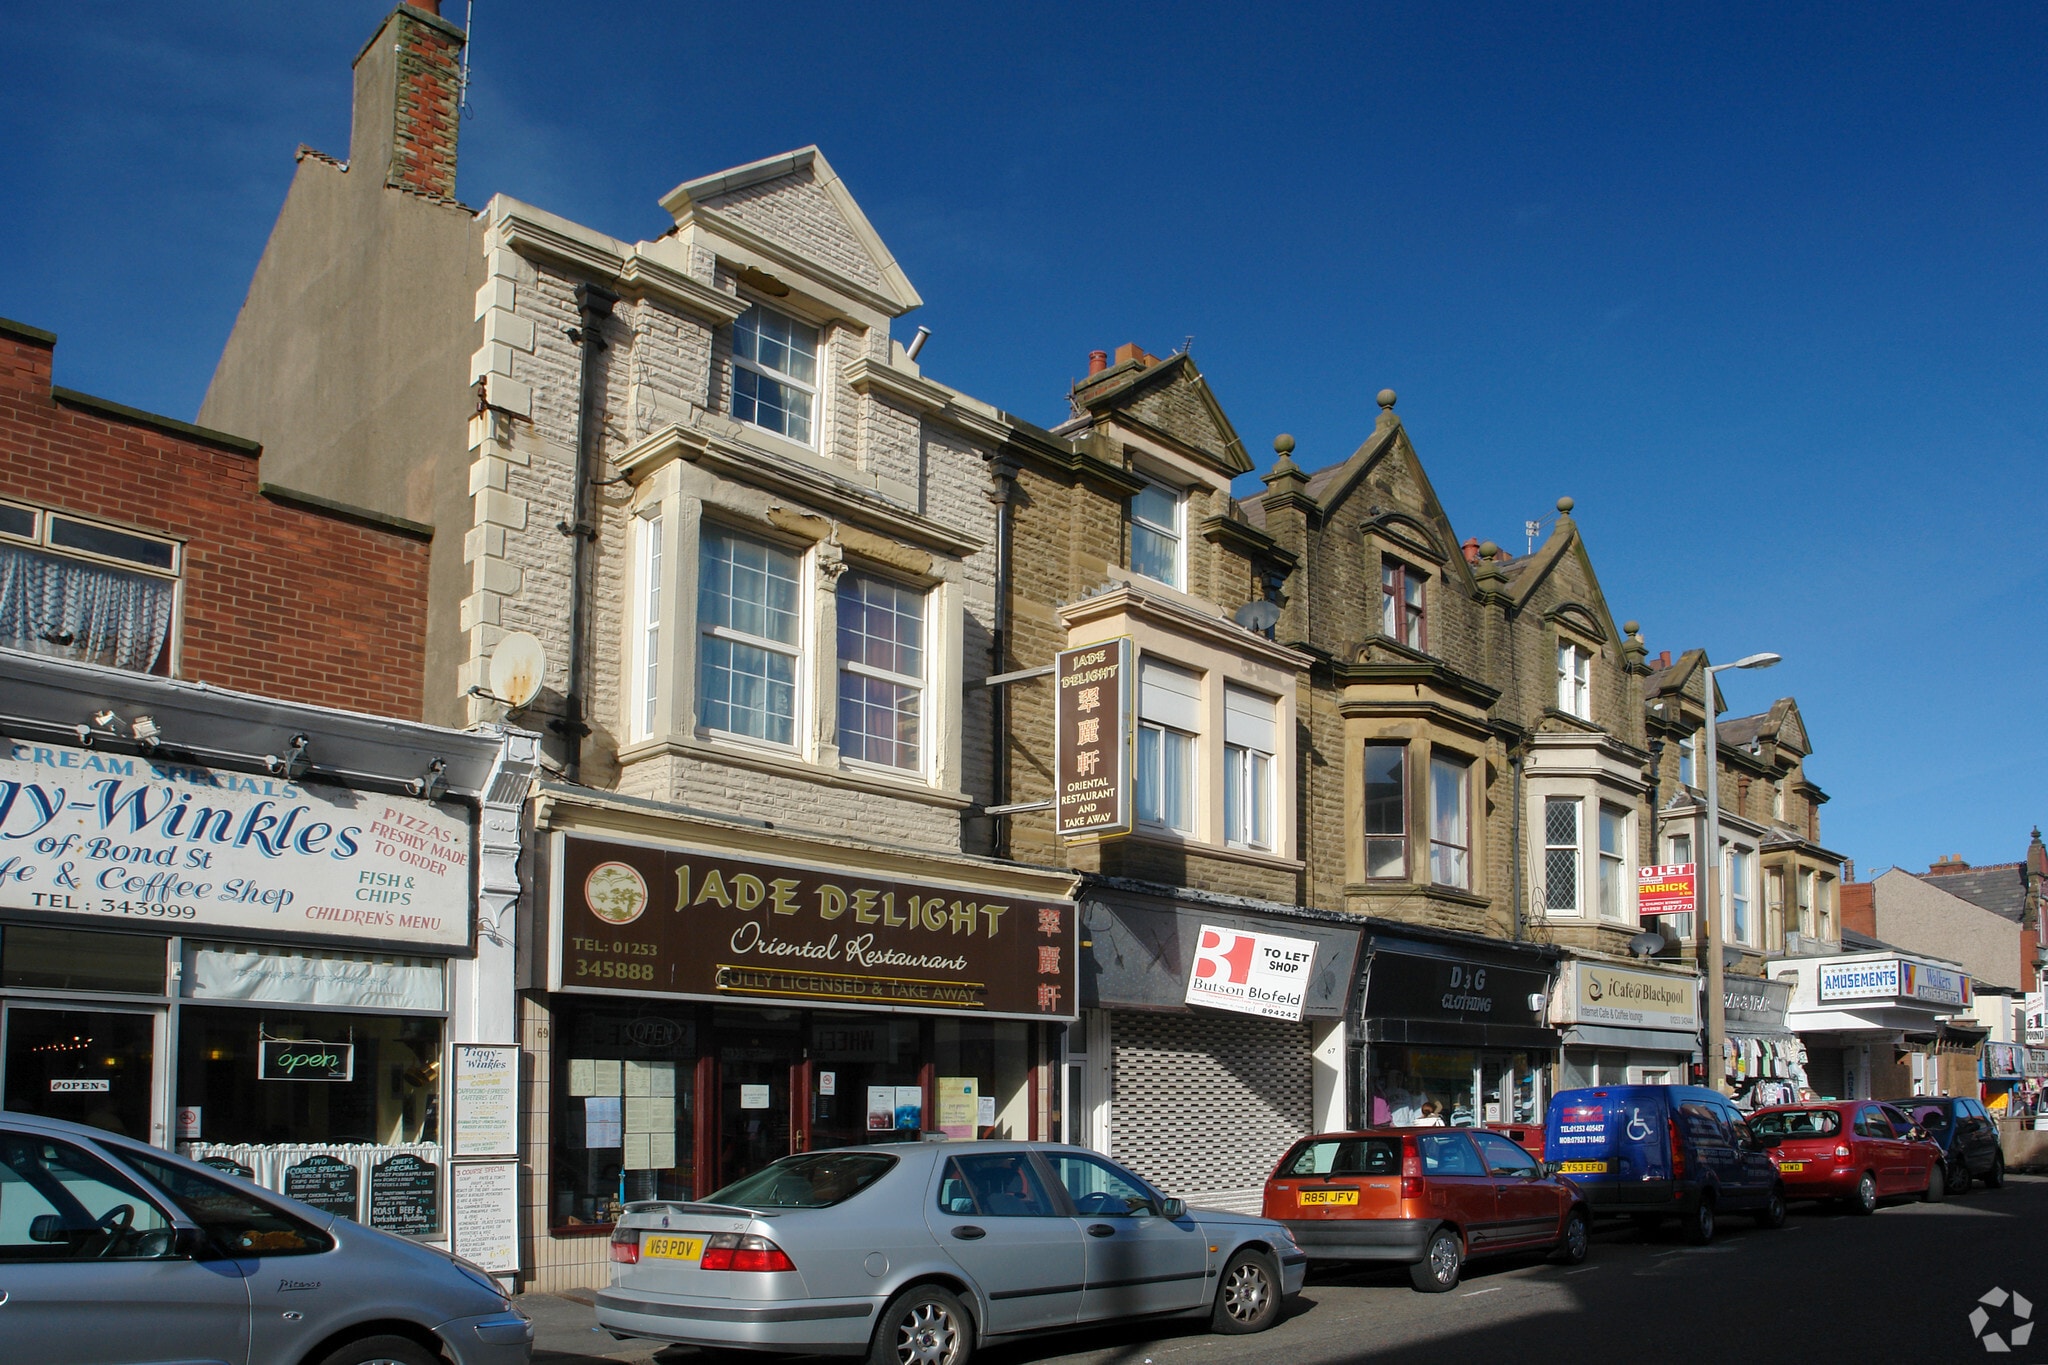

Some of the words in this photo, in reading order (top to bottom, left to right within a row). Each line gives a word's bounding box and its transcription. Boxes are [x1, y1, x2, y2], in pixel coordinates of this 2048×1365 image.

[1073, 650, 1106, 671] JADE
[1061, 664, 1119, 688] DELIGHT
[11, 744, 134, 776] CREAM
[150, 765, 299, 800] SPECIALS
[1067, 777, 1109, 792] ORIENTAL
[1061, 788, 1115, 805] RESTAURANT
[1078, 803, 1097, 814] AND
[384, 807, 452, 843] PIZZAS
[1064, 818, 1085, 828] TAKE
[1086, 812, 1111, 824] AWAY
[34, 833, 81, 860] of
[86, 836, 177, 867] Bond
[185, 848, 212, 871] St
[369, 820, 427, 852] FRESHLY
[429, 839, 468, 867] MADE
[375, 839, 396, 859] TO
[398, 847, 447, 877] ORDER
[1639, 867, 1653, 876] O
[1657, 865, 1686, 875] LET
[54, 861, 80, 891] &
[96, 866, 212, 903] Coffee
[220, 877, 295, 912] Shop
[358, 871, 400, 889] FISH
[403, 876, 416, 889] &
[1639, 882, 1689, 894] ENRICK
[355, 888, 412, 906] CHIPS
[674, 864, 801, 915] JADE
[814, 883, 1010, 938] DELIGHT
[100, 899, 197, 920] 343999
[305, 905, 393, 927] CHILDREN'S
[399, 915, 441, 931] MENU
[573, 938, 609, 953] TEL:
[612, 941, 658, 956] 01253
[730, 921, 840, 962] Oriental
[845, 934, 968, 971] Restaurant
[1264, 947, 1281, 958] TO
[1285, 951, 1309, 963] LET
[575, 958, 654, 982] 345888
[1269, 961, 1298, 973] SHOP
[717, 967, 773, 990] FULLY
[780, 974, 867, 995] LICENSED
[872, 980, 883, 995] &
[887, 981, 928, 998] TAKE
[932, 984, 977, 1002] AWAY
[1824, 970, 1896, 990] AMUSEMENTS
[1926, 968, 1951, 989] Walkers
[1193, 977, 1244, 996] Butson
[1248, 987, 1301, 1005] Blofeld
[1441, 993, 1492, 1012] CLOTHING
[1261, 1008, 1298, 1019] 894242
[1581, 1007, 1598, 1017] Internet
[2027, 1013, 2043, 1028] £1
[537, 1028, 549, 1038] 69
[634, 1023, 673, 1041] OPEN
[2026, 1030, 2044, 1041] POUND
[278, 1052, 339, 1074] open
[466, 1060, 506, 1069] Winkles
[2031, 1051, 2045, 1061] GIFTS
[61, 1081, 100, 1091] OPEN
[290, 1167, 317, 1175] COURSE
[318, 1165, 349, 1173] SPECIALS
[385, 1164, 419, 1172] SPECIALS
[1586, 1163, 1603, 1171] EFO
[1304, 1193, 1327, 1202] R851
[1331, 1192, 1354, 1202] JFV
[373, 1207, 396, 1215] ROAST
[400, 1206, 416, 1214] BEEF
[373, 1215, 402, 1223] Yorkshire
[403, 1214, 427, 1223] Pudding
[650, 1237, 667, 1254] V69
[669, 1238, 693, 1256] PDV
[277, 1279, 321, 1293] Picasso
